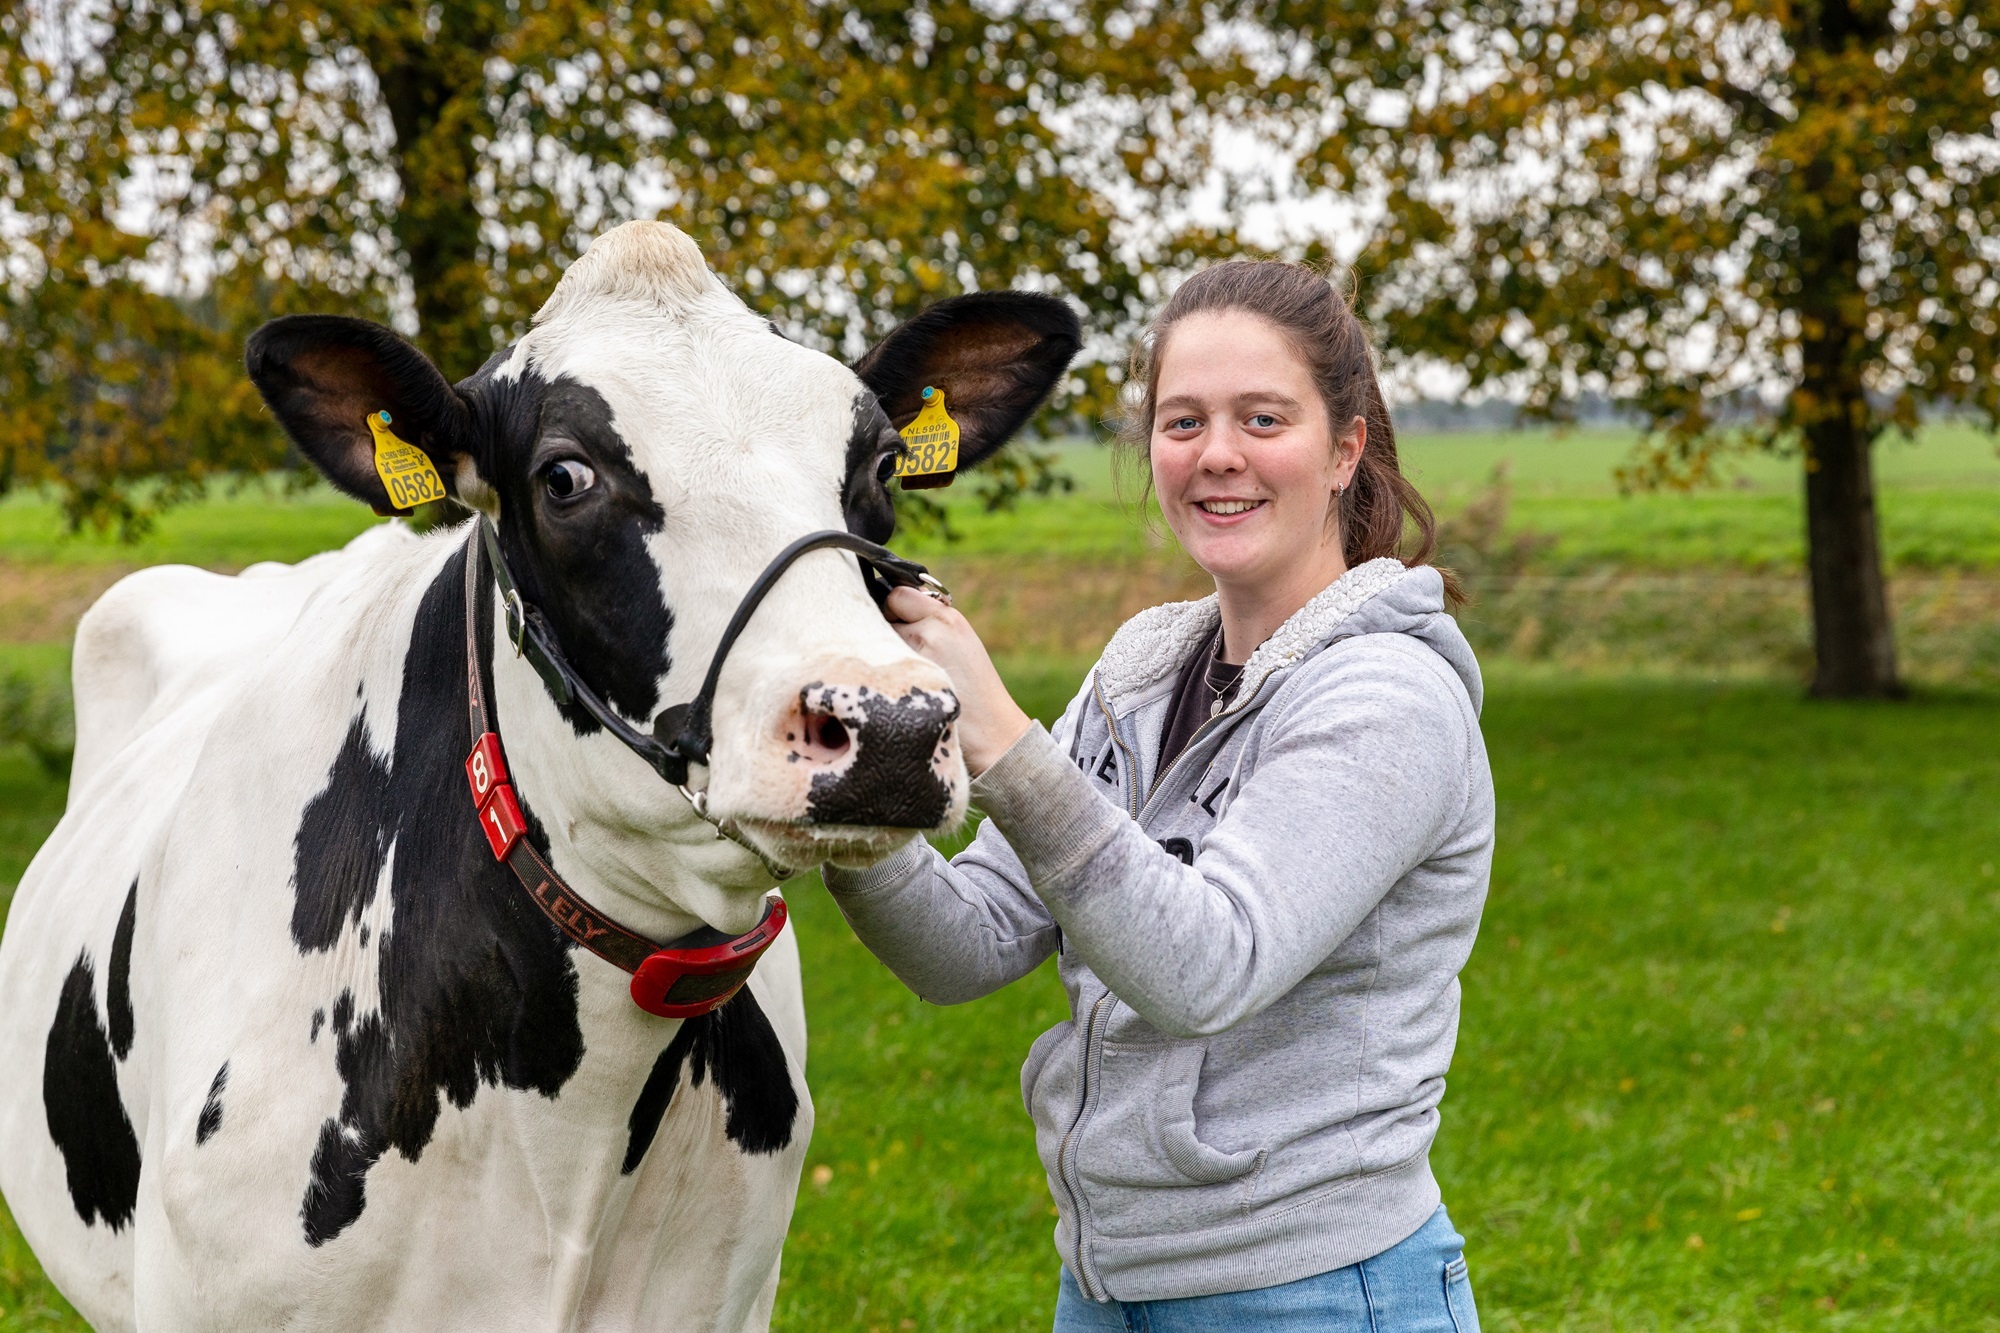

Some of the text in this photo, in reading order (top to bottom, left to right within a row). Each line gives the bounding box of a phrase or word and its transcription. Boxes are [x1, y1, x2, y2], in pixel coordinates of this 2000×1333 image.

[907, 423, 947, 435] NL5909
[951, 440, 957, 451] 2
[391, 469, 444, 506] 0582
[472, 750, 488, 794] 8
[490, 806, 508, 844] 1
[535, 880, 608, 940] LELY
